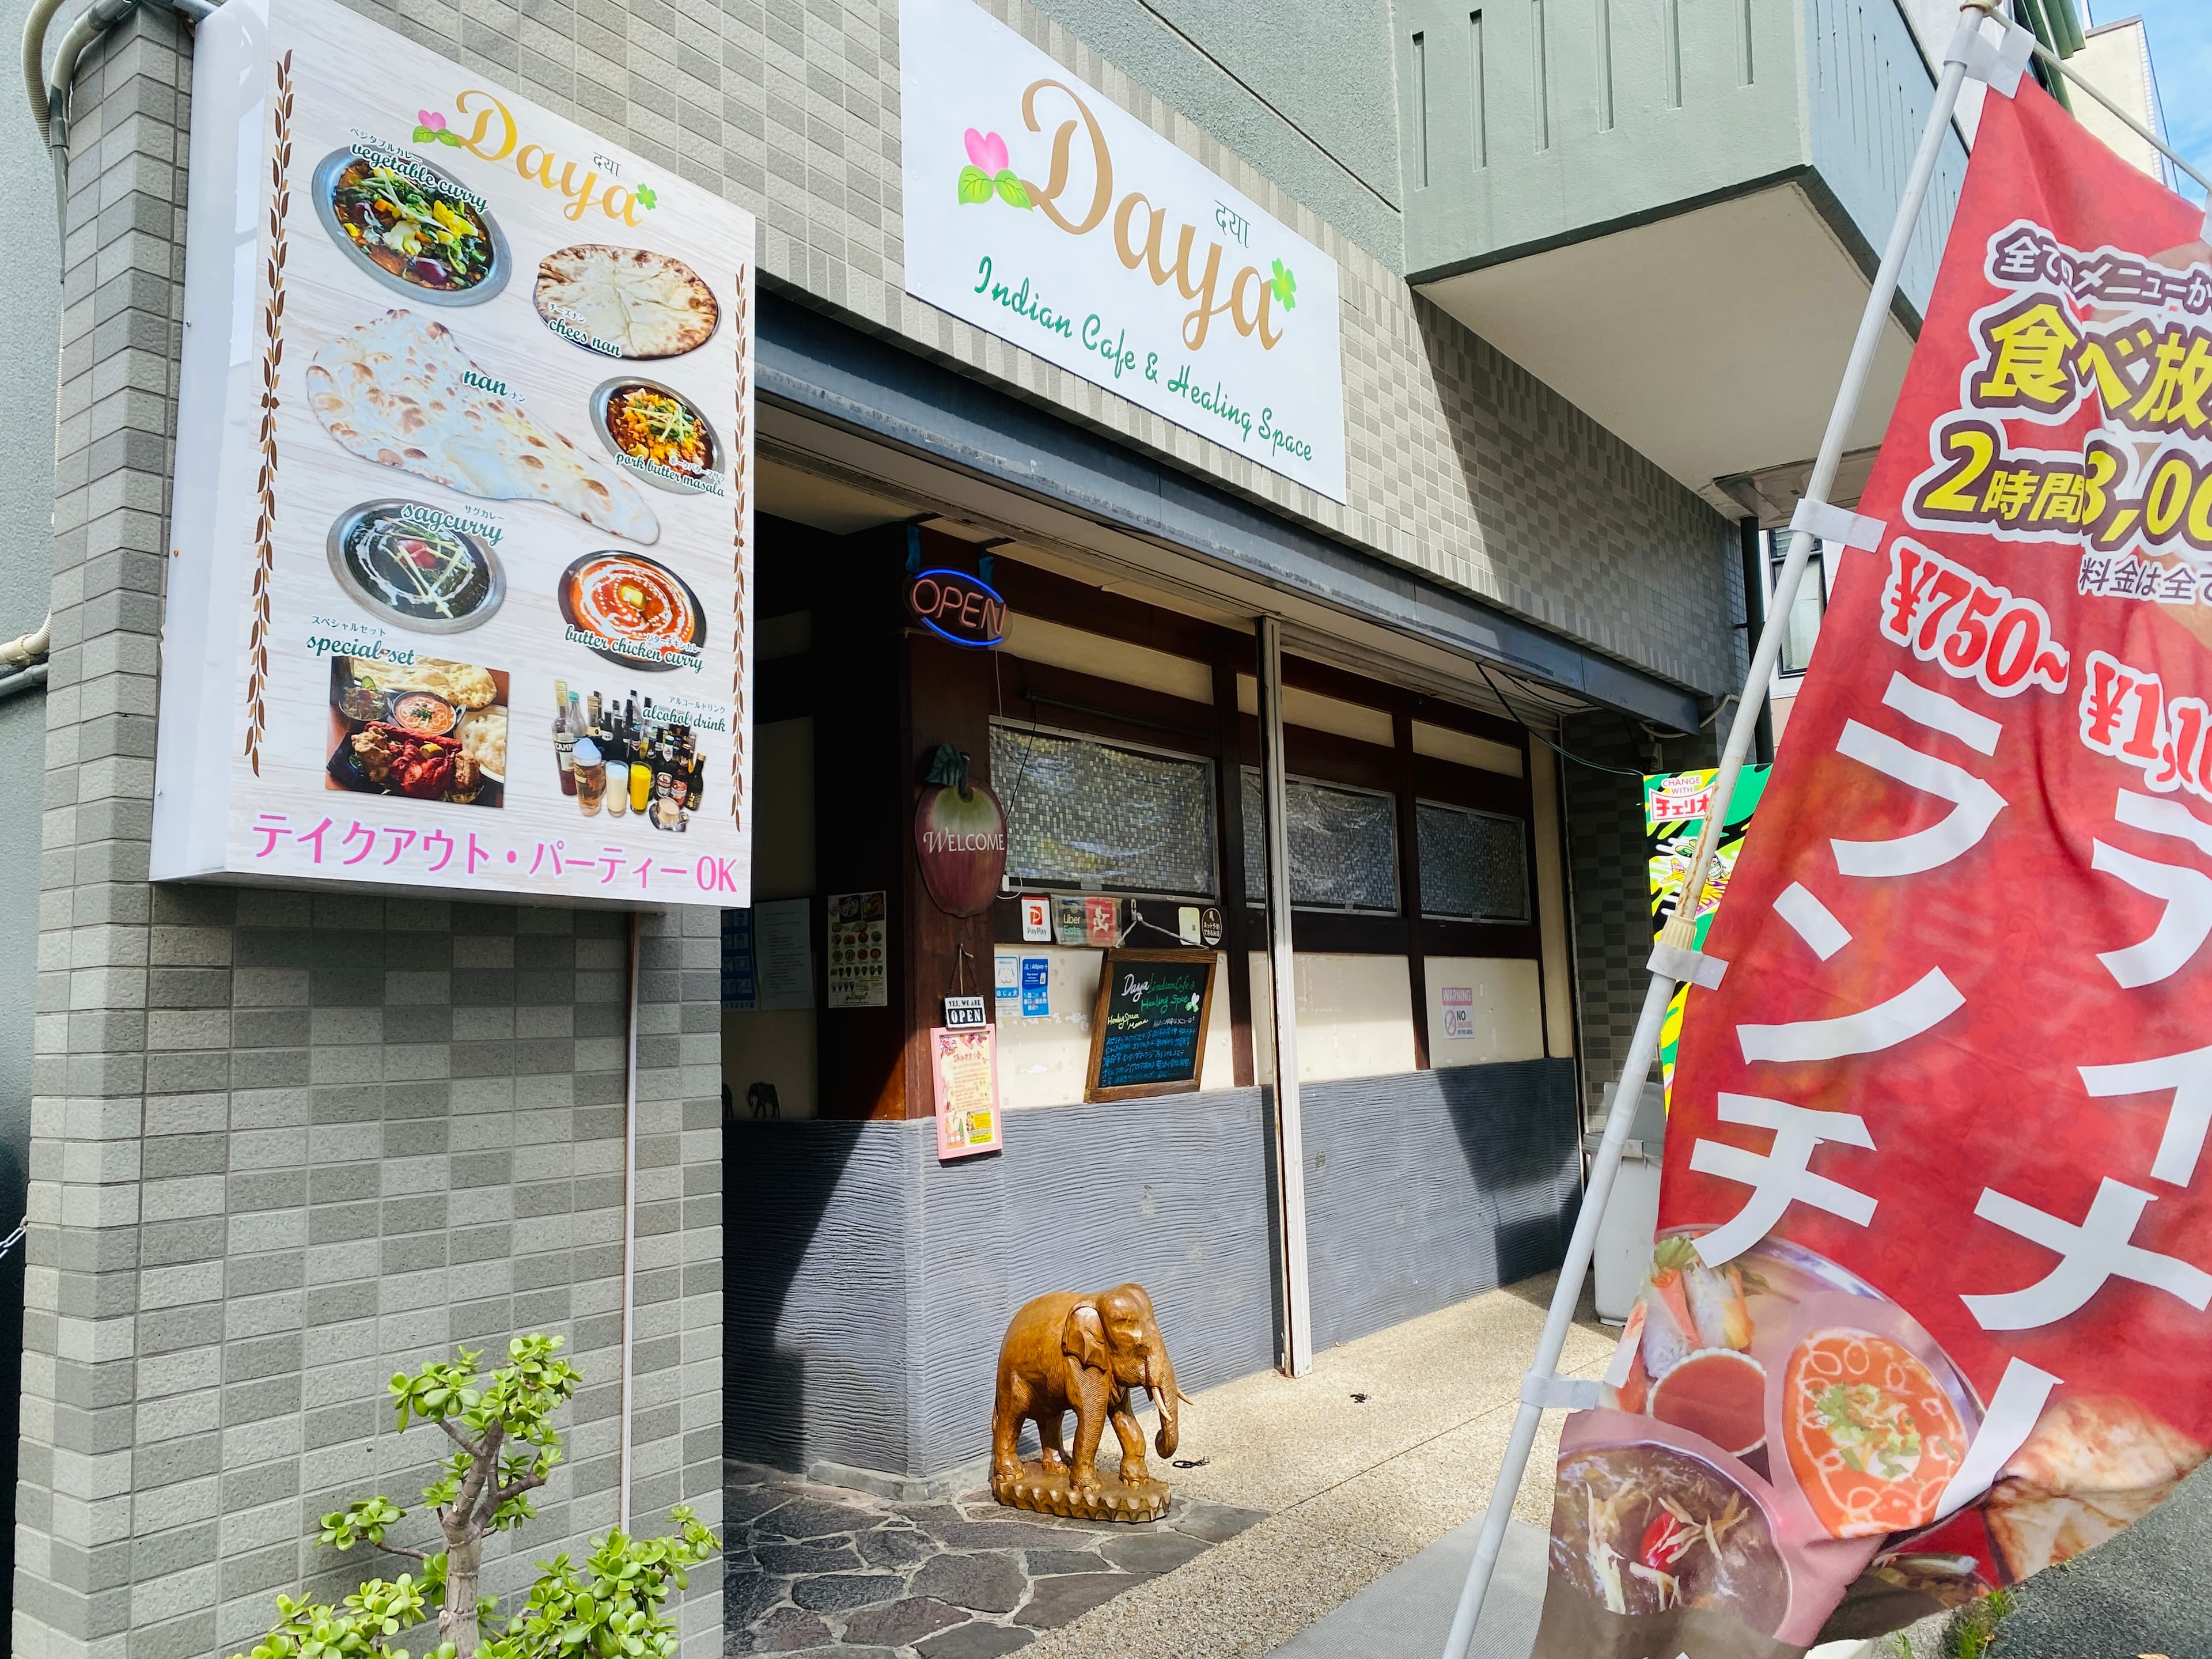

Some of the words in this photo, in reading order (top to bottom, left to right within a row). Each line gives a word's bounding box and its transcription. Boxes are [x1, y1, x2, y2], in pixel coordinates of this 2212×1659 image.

[350, 128, 423, 163] ベジタブルカレー
[454, 89, 645, 228] Daya
[593, 151, 622, 177] दया
[351, 143, 435, 185] vegetable
[439, 181, 488, 213] curry
[1020, 78, 1282, 351] Daya
[1214, 199, 1251, 249] दया
[548, 303, 585, 322] チーズナン
[549, 319, 588, 344] chees
[592, 336, 622, 357] nan
[974, 256, 1072, 339] Indian
[1082, 313, 1136, 380] Cafe
[1145, 352, 1159, 385] &
[1167, 365, 1253, 442] Healing
[1258, 407, 1313, 461] Space
[463, 370, 507, 396] nan
[510, 392, 525, 402] ナン
[616, 453, 644, 469] pork
[647, 459, 681, 482] butter
[683, 476, 725, 497] masala
[669, 457, 725, 482] ポークバターマサラ
[464, 505, 505, 520] サグカレー
[403, 505, 503, 547] sagcurry
[912, 578, 1007, 634] OPEN
[312, 616, 386, 637] スペシャルセット
[306, 636, 382, 660] special
[388, 649, 415, 665] set
[565, 625, 608, 649] butter
[612, 637, 662, 661] chicken
[665, 652, 703, 673] curry
[647, 635, 705, 653] バターチキンカレー
[669, 696, 726, 714] アルコールドリンク
[642, 705, 691, 725] alcohol
[694, 714, 726, 732] drink
[1662, 777, 1700, 787] CHANGE
[1671, 786, 1693, 794] WITH
[1656, 794, 1710, 817] チェリオ
[923, 827, 1005, 854] WELCOME
[1027, 927, 1047, 935] PayPay
[1063, 914, 1081, 925] Uber
[1063, 926, 1081, 935] Eats
[1690, 671, 2009, 1268] ランチ
[1121, 974, 1150, 1002] Daya
[1442, 989, 1471, 1002] WARNING
[951, 1009, 981, 1024] OPEN
[1456, 1010, 1466, 1021] NO
